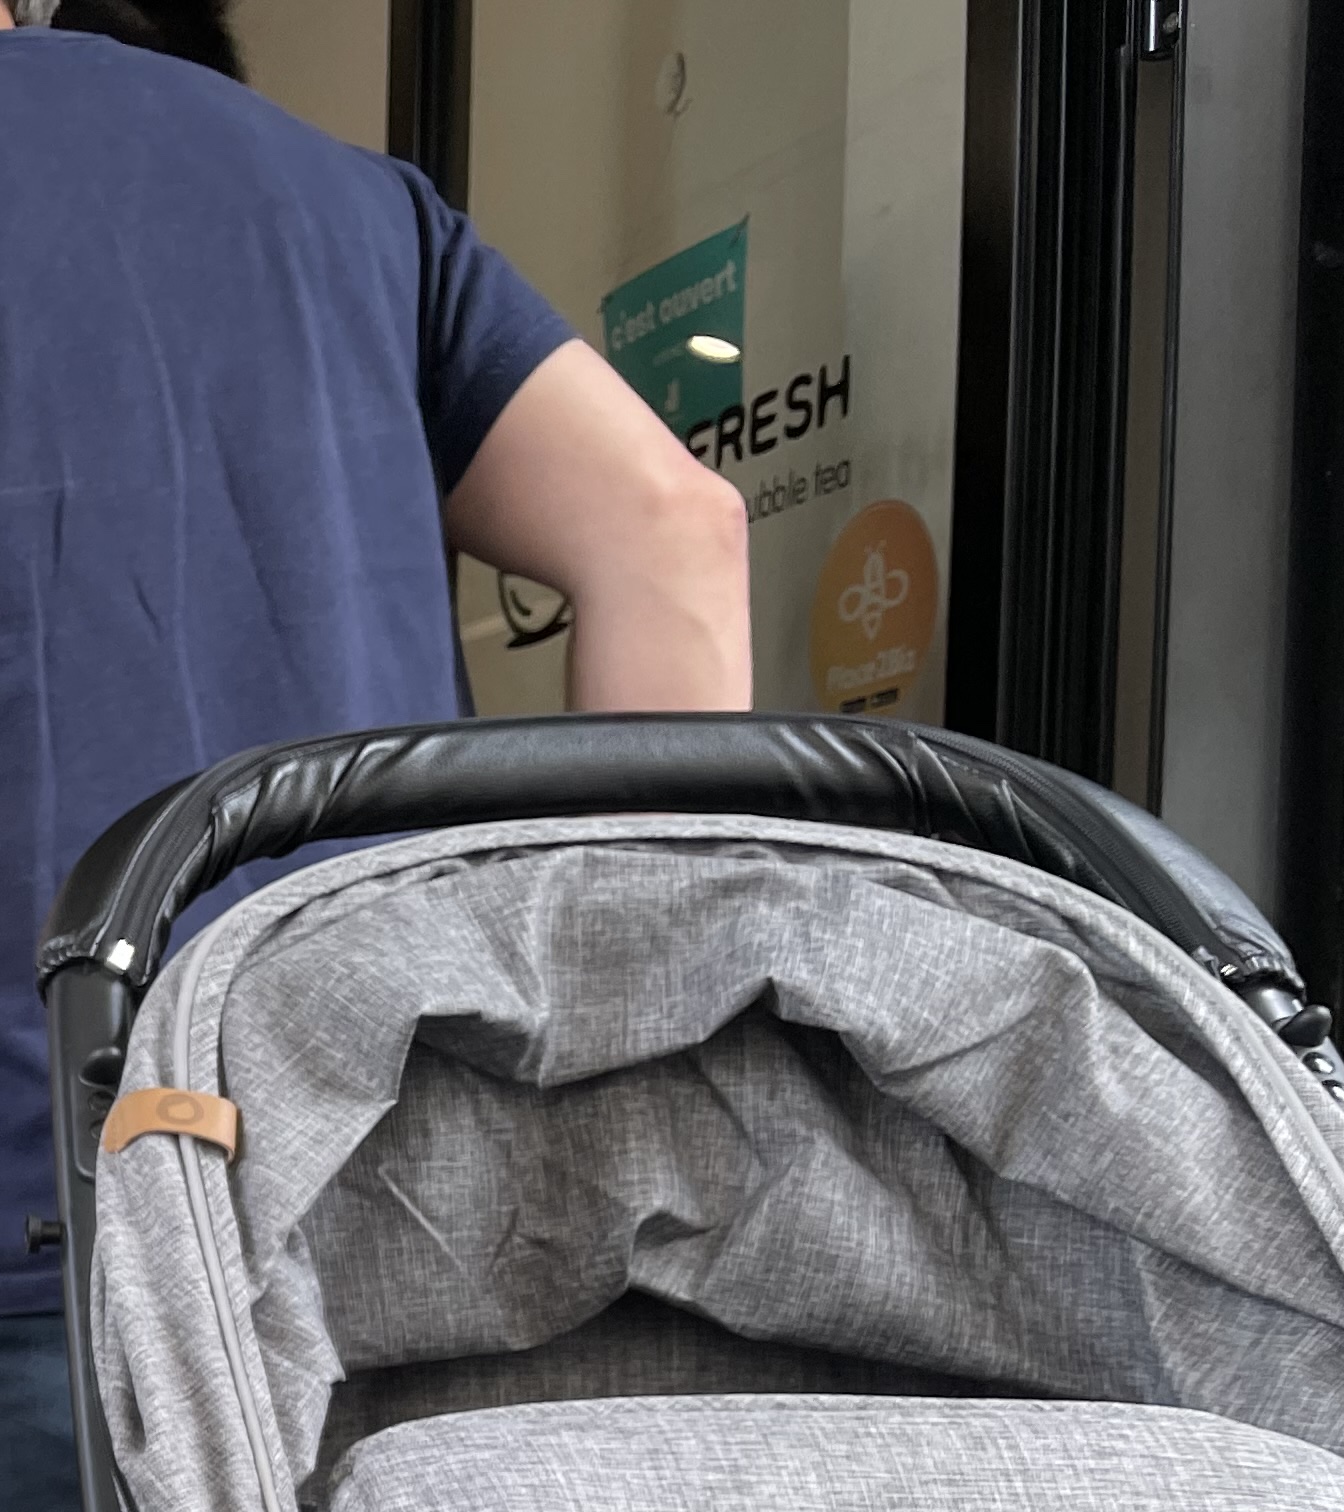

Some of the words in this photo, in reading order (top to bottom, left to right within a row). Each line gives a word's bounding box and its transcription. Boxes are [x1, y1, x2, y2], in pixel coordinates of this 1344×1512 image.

[659, 259, 737, 325] ouvert
[685, 354, 851, 470] FRESH
[747, 467, 809, 524] ubble
[814, 459, 851, 498] tea
